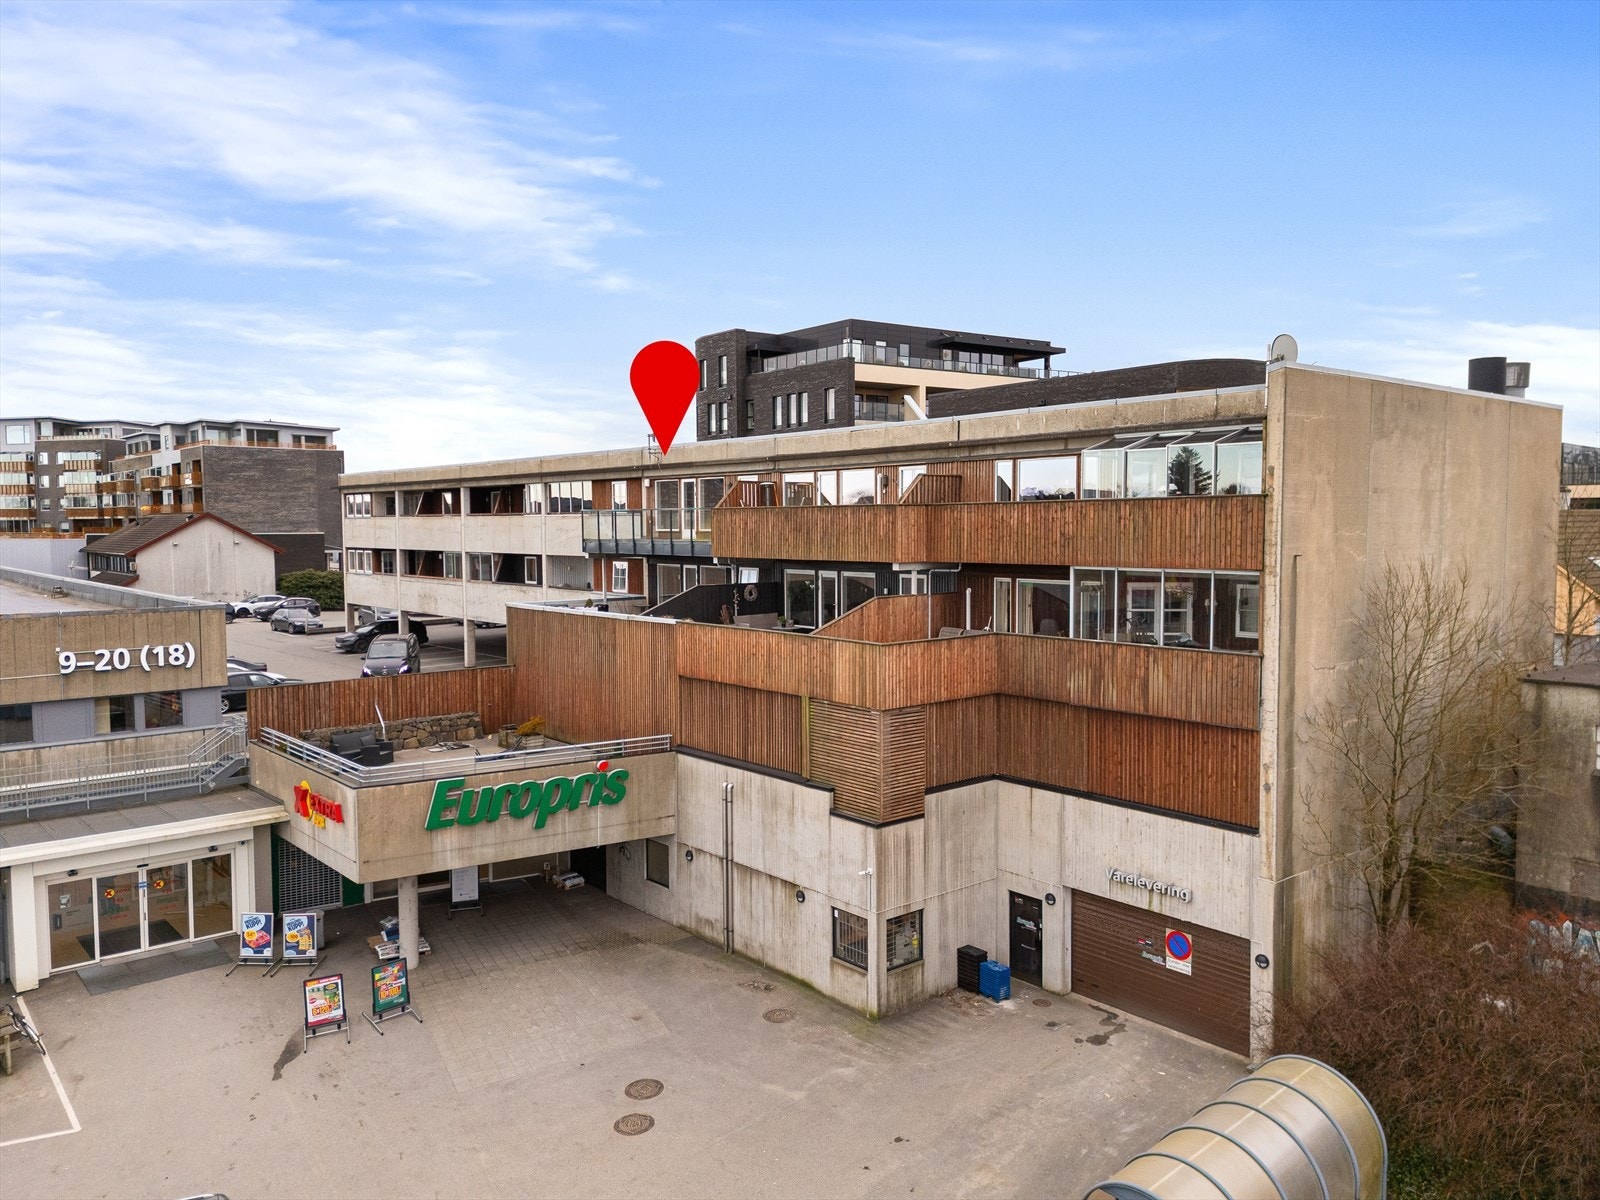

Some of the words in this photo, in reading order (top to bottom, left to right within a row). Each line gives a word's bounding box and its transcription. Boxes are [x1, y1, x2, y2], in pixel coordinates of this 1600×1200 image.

[140, 642, 196, 672] (18)
[424, 760, 630, 831] Europris
[1105, 867, 1192, 903] Varelevering
